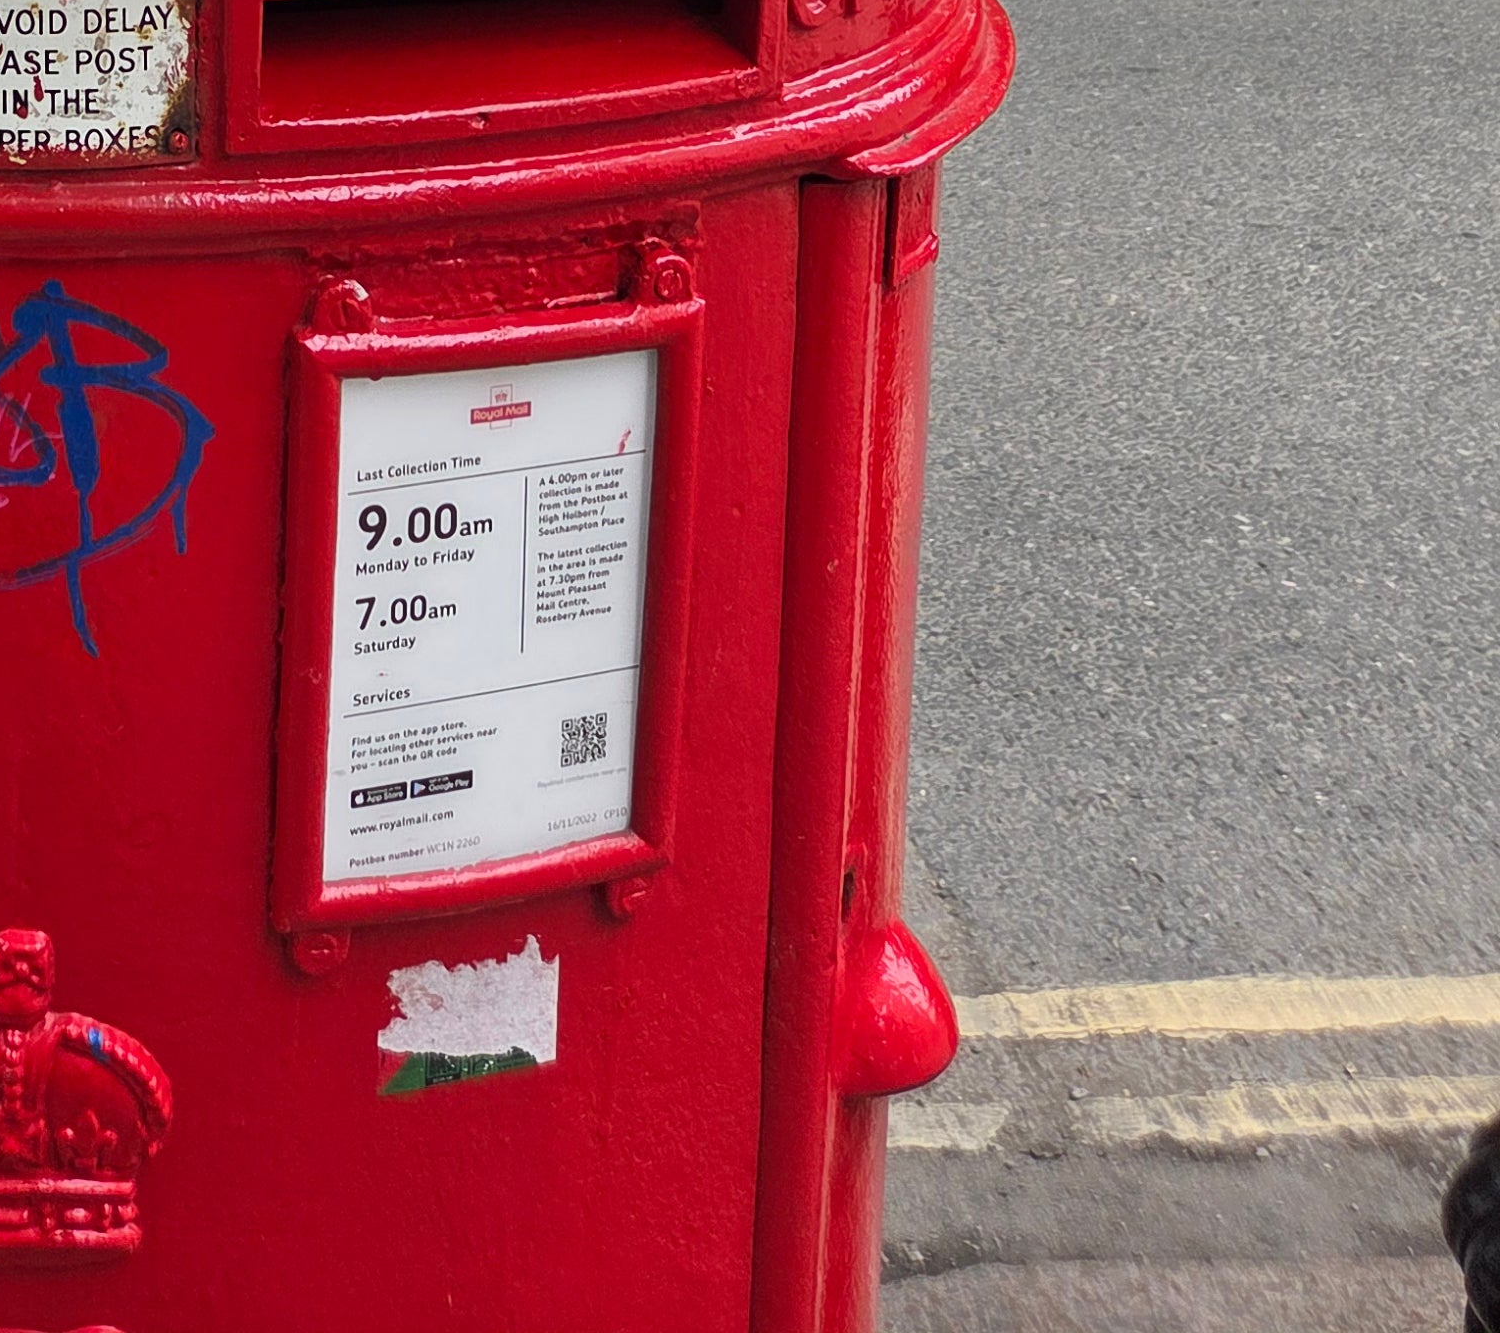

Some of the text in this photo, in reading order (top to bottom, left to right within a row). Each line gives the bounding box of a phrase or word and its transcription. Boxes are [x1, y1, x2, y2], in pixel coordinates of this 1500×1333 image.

[84, 5, 174, 33] DELAY
[75, 45, 153, 74] POST
[2, 88, 100, 115] IN THE
[65, 125, 160, 152] BOXES
[473, 403, 529, 422] Royal Mail
[357, 455, 481, 482] Last Collection Time
[539, 468, 624, 486] A 4.00pm or later
[539, 481, 619, 499] collection is made
[539, 491, 628, 512] from the Postbox at
[358, 503, 493, 550] 9.00am
[538, 517, 625, 536] Southampton Place
[539, 509, 598, 524] High Holborn
[538, 541, 628, 561] The latest collection
[356, 548, 475, 577] Monday to Friday
[537, 554, 623, 573] in the area is made
[537, 570, 609, 587] at 7.30pm from
[537, 582, 606, 599] Mount Pleasant
[355, 595, 457, 630] 7.00am
[536, 606, 611, 624] Rosebery Avenue
[537, 601, 555, 612] Mail
[354, 635, 416, 655] Saturday
[353, 687, 410, 706] Services
[352, 721, 467, 746] Find us on the app store.
[352, 728, 497, 759] For locating other services near
[351, 746, 457, 773] you scan the QR code
[350, 809, 454, 837] www.royalmail.com
[548, 812, 597, 832] 16/11/2022
[349, 847, 424, 868] Postbox number
